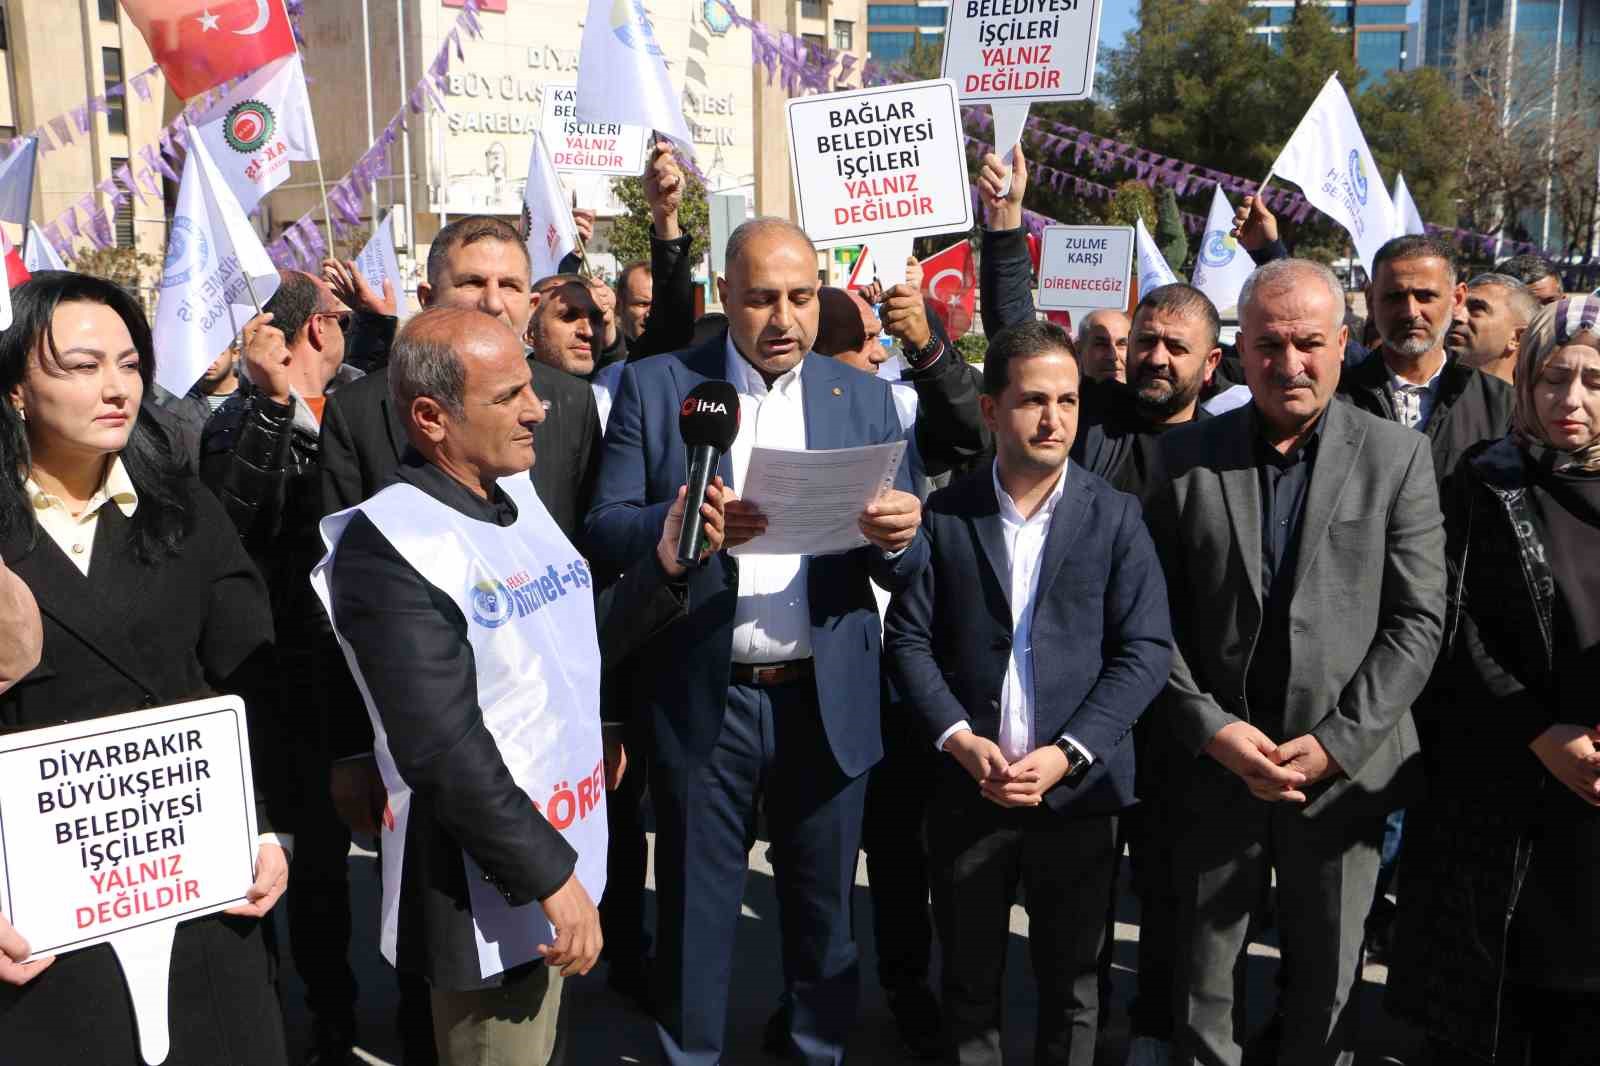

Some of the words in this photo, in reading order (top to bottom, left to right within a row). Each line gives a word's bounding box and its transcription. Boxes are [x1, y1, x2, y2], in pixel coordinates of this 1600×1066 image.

[979, 15, 1059, 46] İŞÇİLERİ
[982, 45, 1052, 66] YALNIZ
[965, 66, 1060, 92] DEĞİLDİR
[829, 102, 915, 128] BAĞLAR
[566, 137, 616, 151] YALNIZ
[817, 118, 934, 153] BELEDİYESİ
[553, 151, 623, 167] DEĞİLDİR
[836, 145, 920, 179] İŞÇİLERİ
[845, 174, 919, 199] YALNIZ
[834, 194, 934, 226] DEĞİLDİR
[1066, 237, 1108, 250] ZULME
[1068, 252, 1103, 267] KARŞI
[1044, 275, 1122, 292] DİRENECEĞİZ
[39, 729, 202, 780] DİYARBAKIR
[38, 757, 211, 814] BÜYÜKŞEHİR
[533, 758, 604, 830] ÖRE
[55, 787, 202, 844] BELEDİYESİ
[80, 819, 185, 871] İŞÇİLERİ
[90, 854, 183, 894] YALNIZ
[75, 879, 201, 929] DEĞİLDİR
